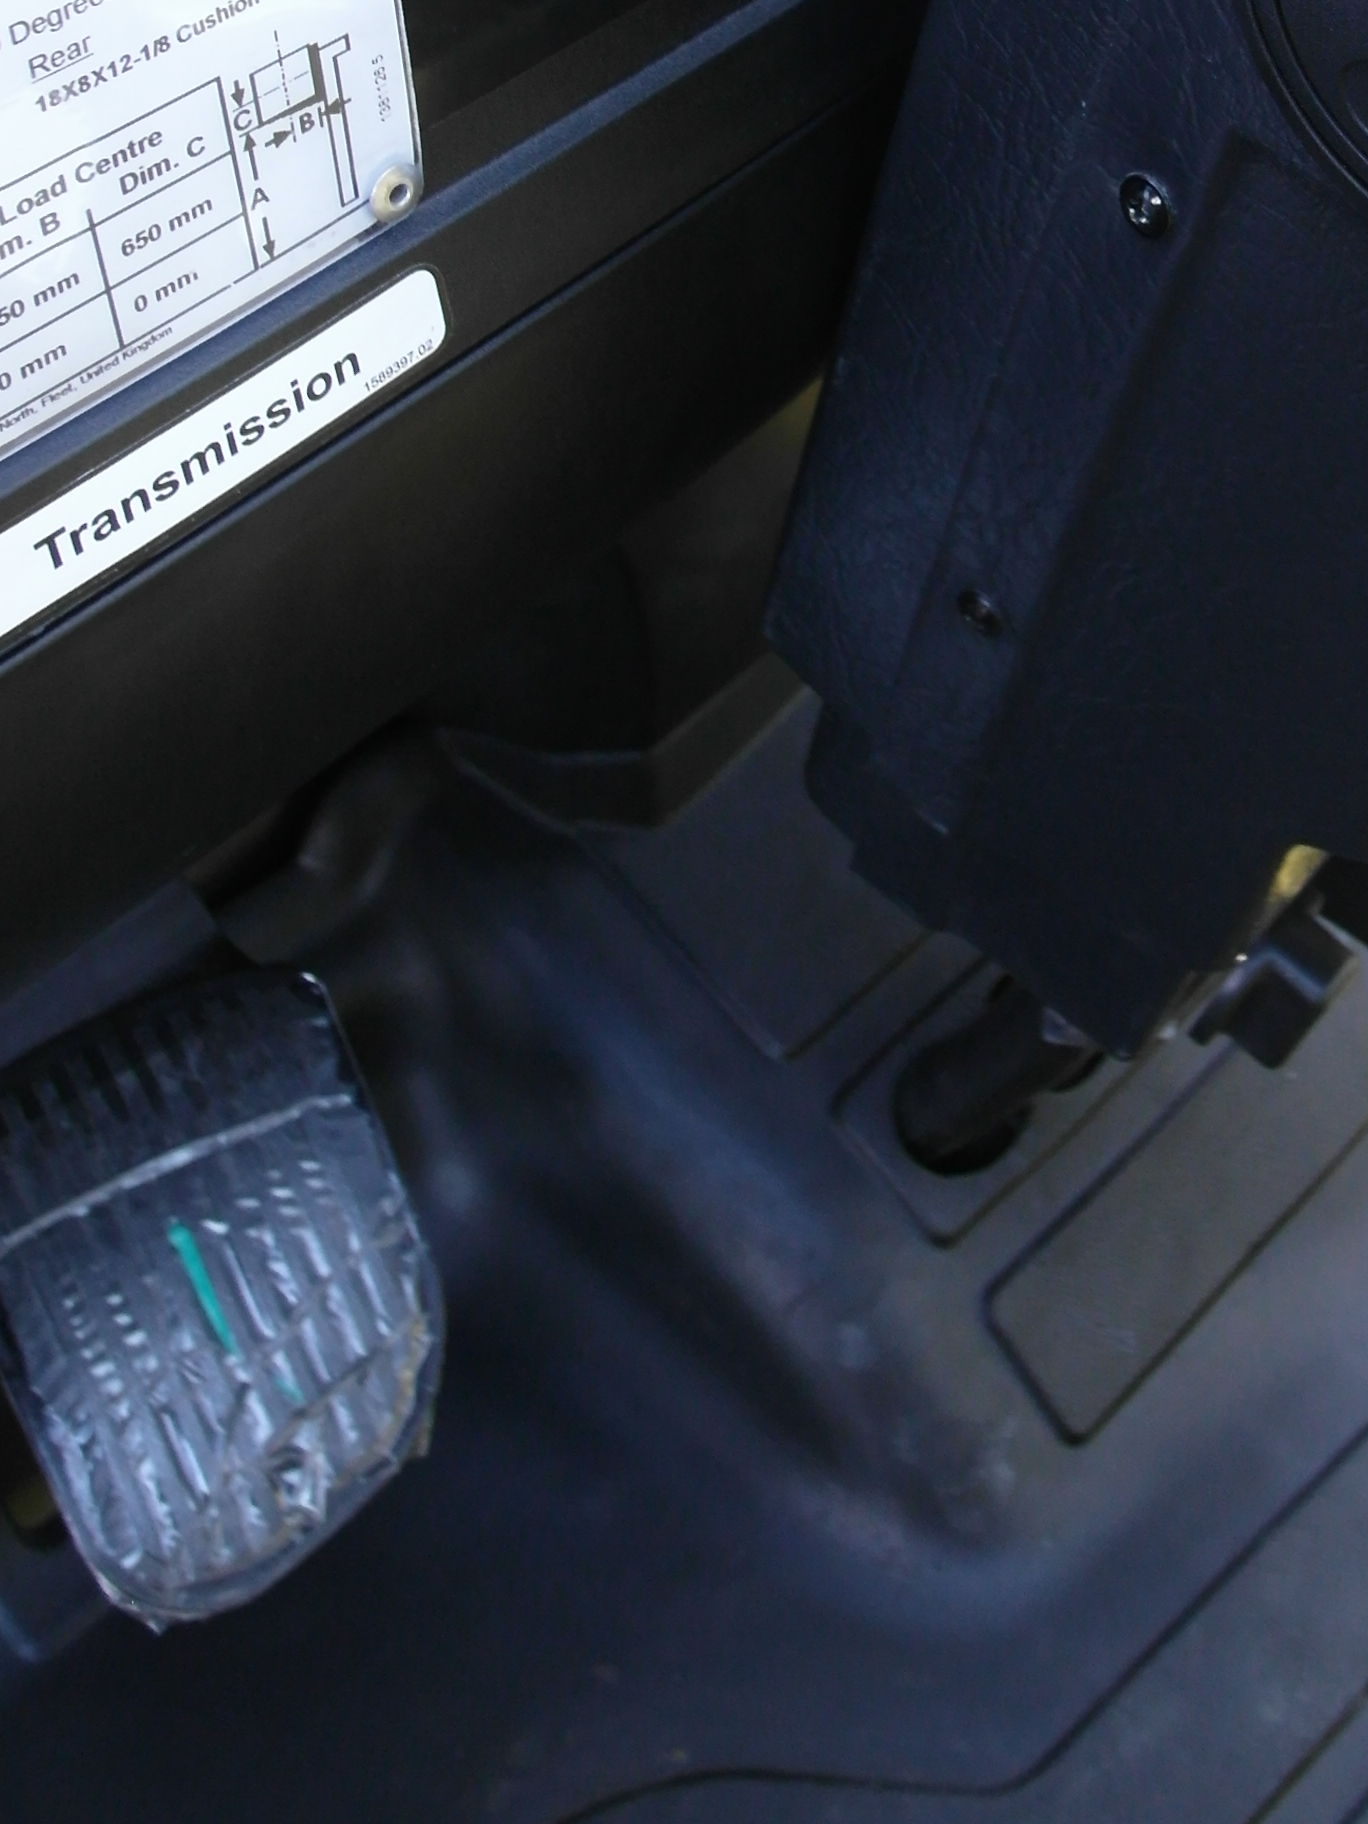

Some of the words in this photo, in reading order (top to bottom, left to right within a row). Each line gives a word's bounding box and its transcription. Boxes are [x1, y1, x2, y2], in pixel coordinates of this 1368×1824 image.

[28, 36, 94, 79] Rear
[34, 35, 171, 113] 18X8X12-1/8
[233, 109, 254, 132] C
[299, 112, 316, 135] B
[0, 174, 68, 226] Load
[74, 130, 163, 185] Centre
[39, 212, 61, 237] B
[119, 157, 179, 195] Dim.
[186, 136, 206, 159] C
[251, 187, 271, 212] A
[33, 272, 81, 307] mm
[120, 223, 163, 258] 650
[168, 198, 213, 233] mm
[20, 344, 68, 380] mm
[133, 294, 148, 313] 0
[155, 270, 199, 302] mm
[79, 355, 121, 386] United
[122, 325, 174, 363] Kingdom
[363, 338, 434, 392] 1589397.02
[33, 351, 361, 570] Transmission
